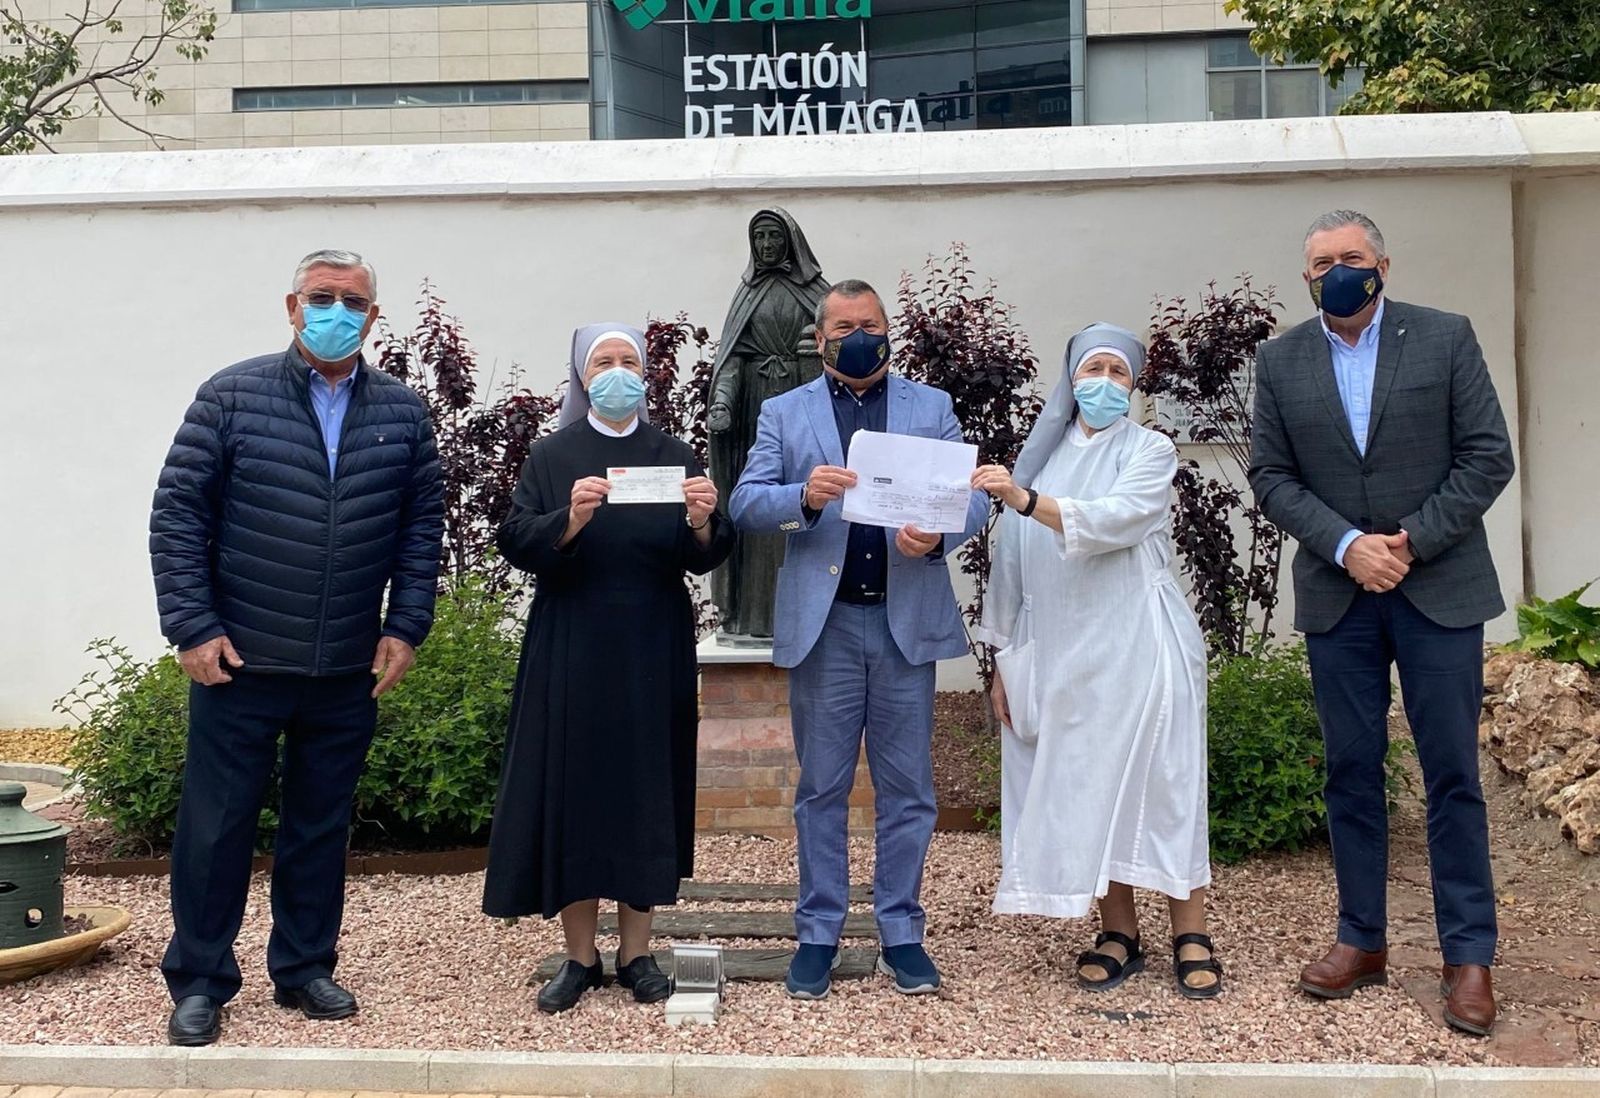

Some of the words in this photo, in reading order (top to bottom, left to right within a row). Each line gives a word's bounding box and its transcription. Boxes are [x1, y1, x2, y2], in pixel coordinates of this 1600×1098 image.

[684, 42, 867, 92] ESTACIÓN
[684, 104, 735, 138] DE
[753, 93, 924, 136] MÁLAGA
